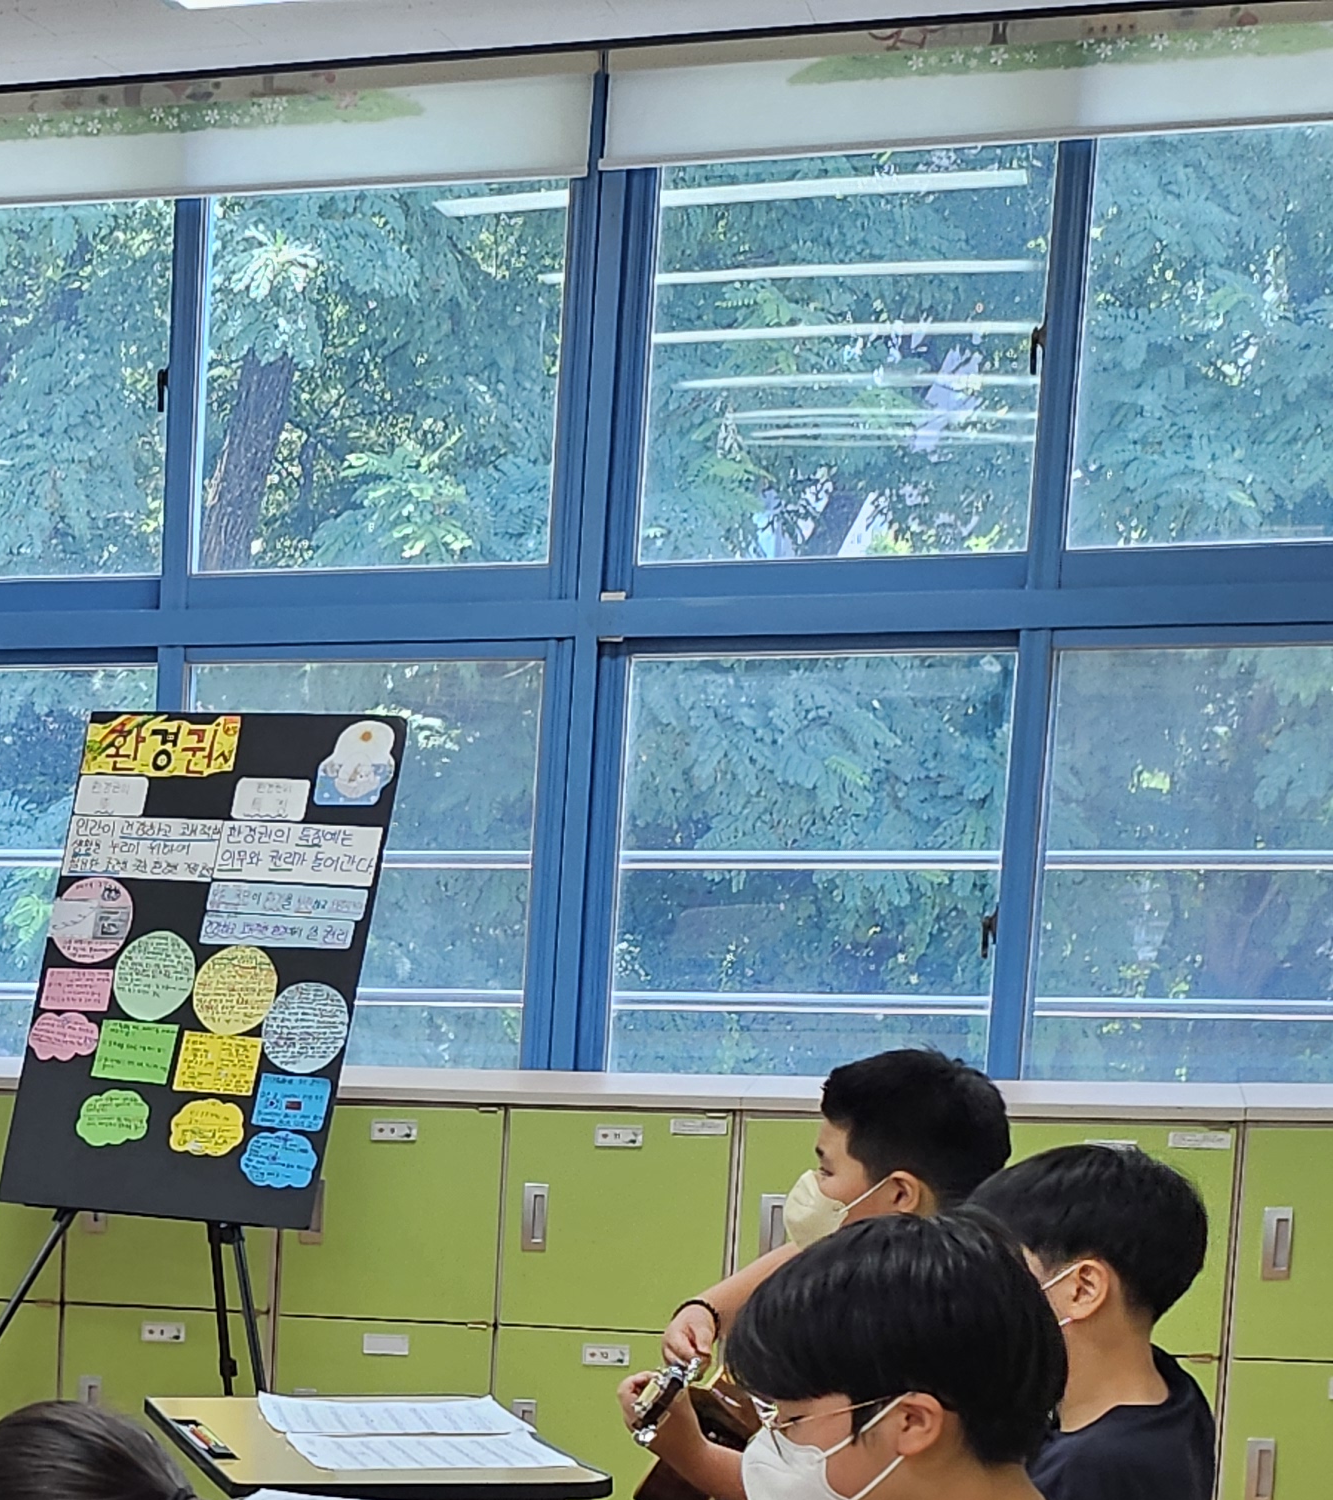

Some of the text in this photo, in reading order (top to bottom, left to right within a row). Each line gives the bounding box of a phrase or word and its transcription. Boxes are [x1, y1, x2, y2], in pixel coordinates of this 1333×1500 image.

[101, 722, 219, 776] 환경권
[75, 817, 116, 837] 인간이
[119, 820, 172, 838] 건강하고
[226, 824, 292, 845] 환경권의
[217, 848, 263, 868] 의무와
[268, 849, 308, 868] 권리가
